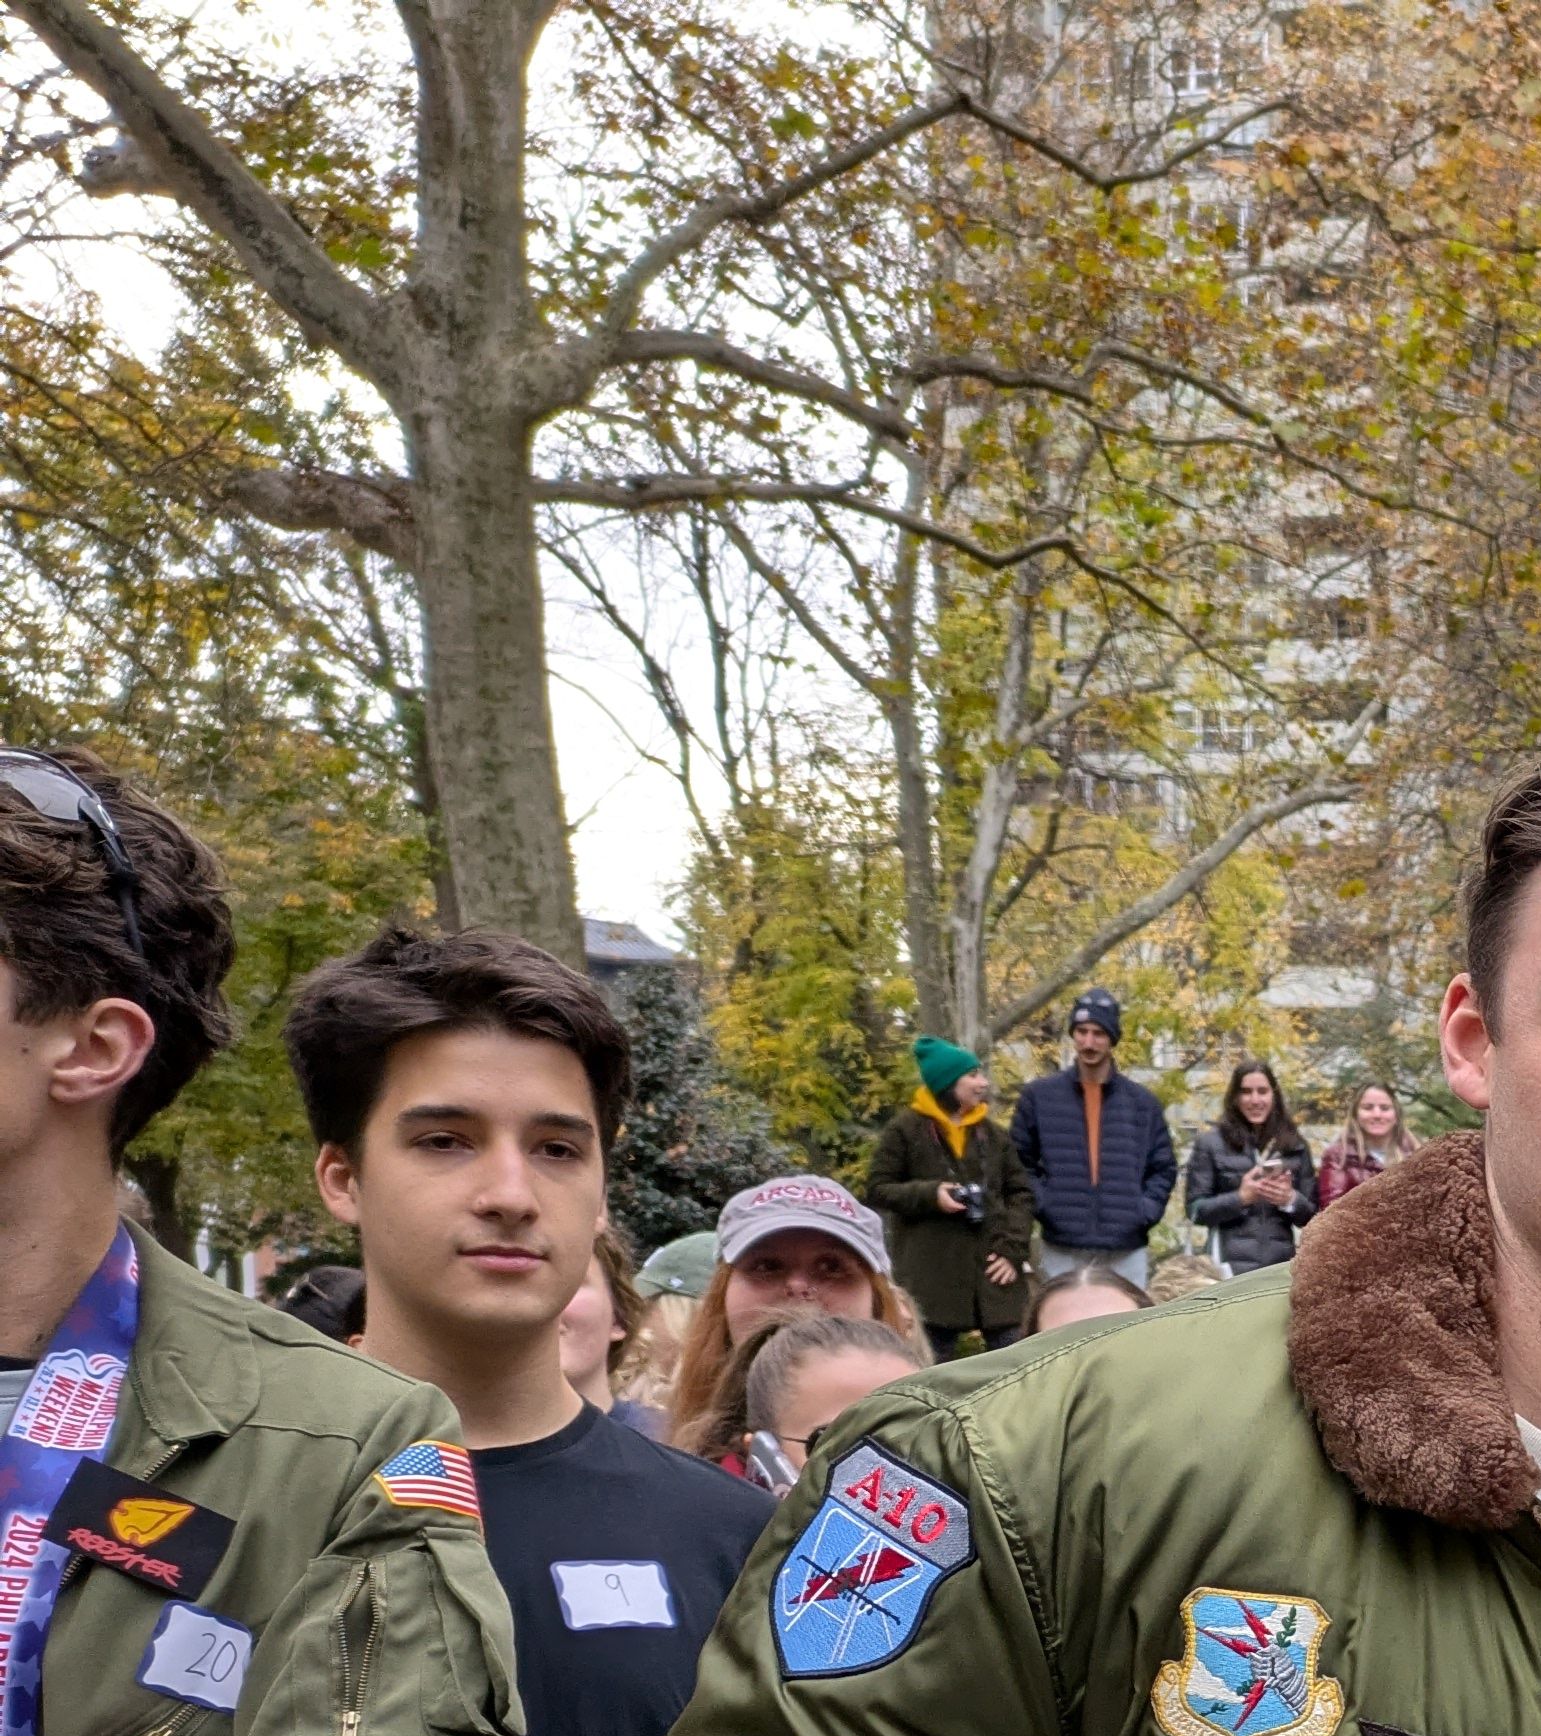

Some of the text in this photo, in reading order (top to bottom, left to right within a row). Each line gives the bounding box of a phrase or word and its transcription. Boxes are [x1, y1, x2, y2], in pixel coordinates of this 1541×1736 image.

[29, 1374, 78, 1443] WEEKEND
[53, 1378, 105, 1448] MARATHON
[79, 1369, 125, 1449] HILADELPHIA
[844, 1466, 949, 1545] A-10
[0, 1514, 47, 1568] 2024
[67, 1528, 183, 1587] ROOSTER
[604, 1573, 630, 1606] 9
[185, 1632, 237, 1682] 20
